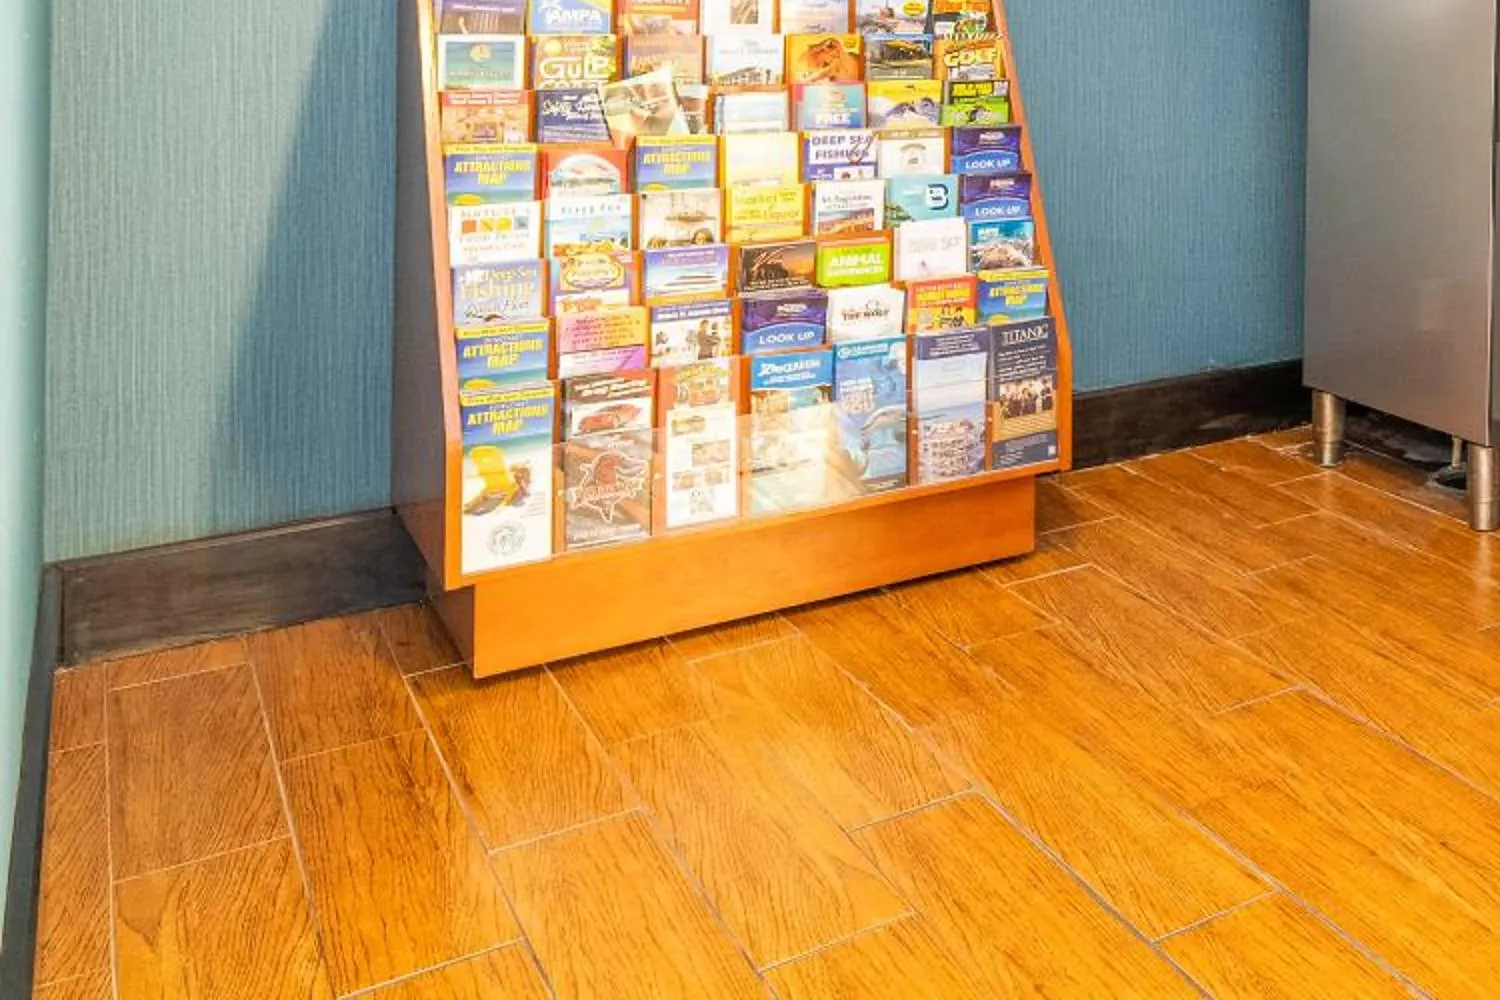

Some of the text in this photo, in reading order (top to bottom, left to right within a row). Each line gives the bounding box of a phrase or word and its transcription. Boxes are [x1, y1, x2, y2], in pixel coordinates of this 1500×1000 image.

[943, 49, 997, 67] GOLF
[811, 134, 874, 146] DEEP SEA
[815, 148, 870, 160] FISHING
[454, 159, 531, 174] ATTRACTIONS
[663, 162, 690, 174] MAP
[965, 158, 1012, 170] LOOK UP
[477, 172, 507, 185] MAP
[975, 205, 1021, 217] LOOK UP
[828, 253, 883, 266] ANIMAL
[759, 331, 815, 345] LOOK UP
[1001, 324, 1049, 346] TITANIC
[463, 338, 545, 359] ATTRACTIONS
[487, 354, 518, 369] MAP
[467, 405, 548, 426] ATTRACTIONS
[493, 419, 524, 436] MAP
